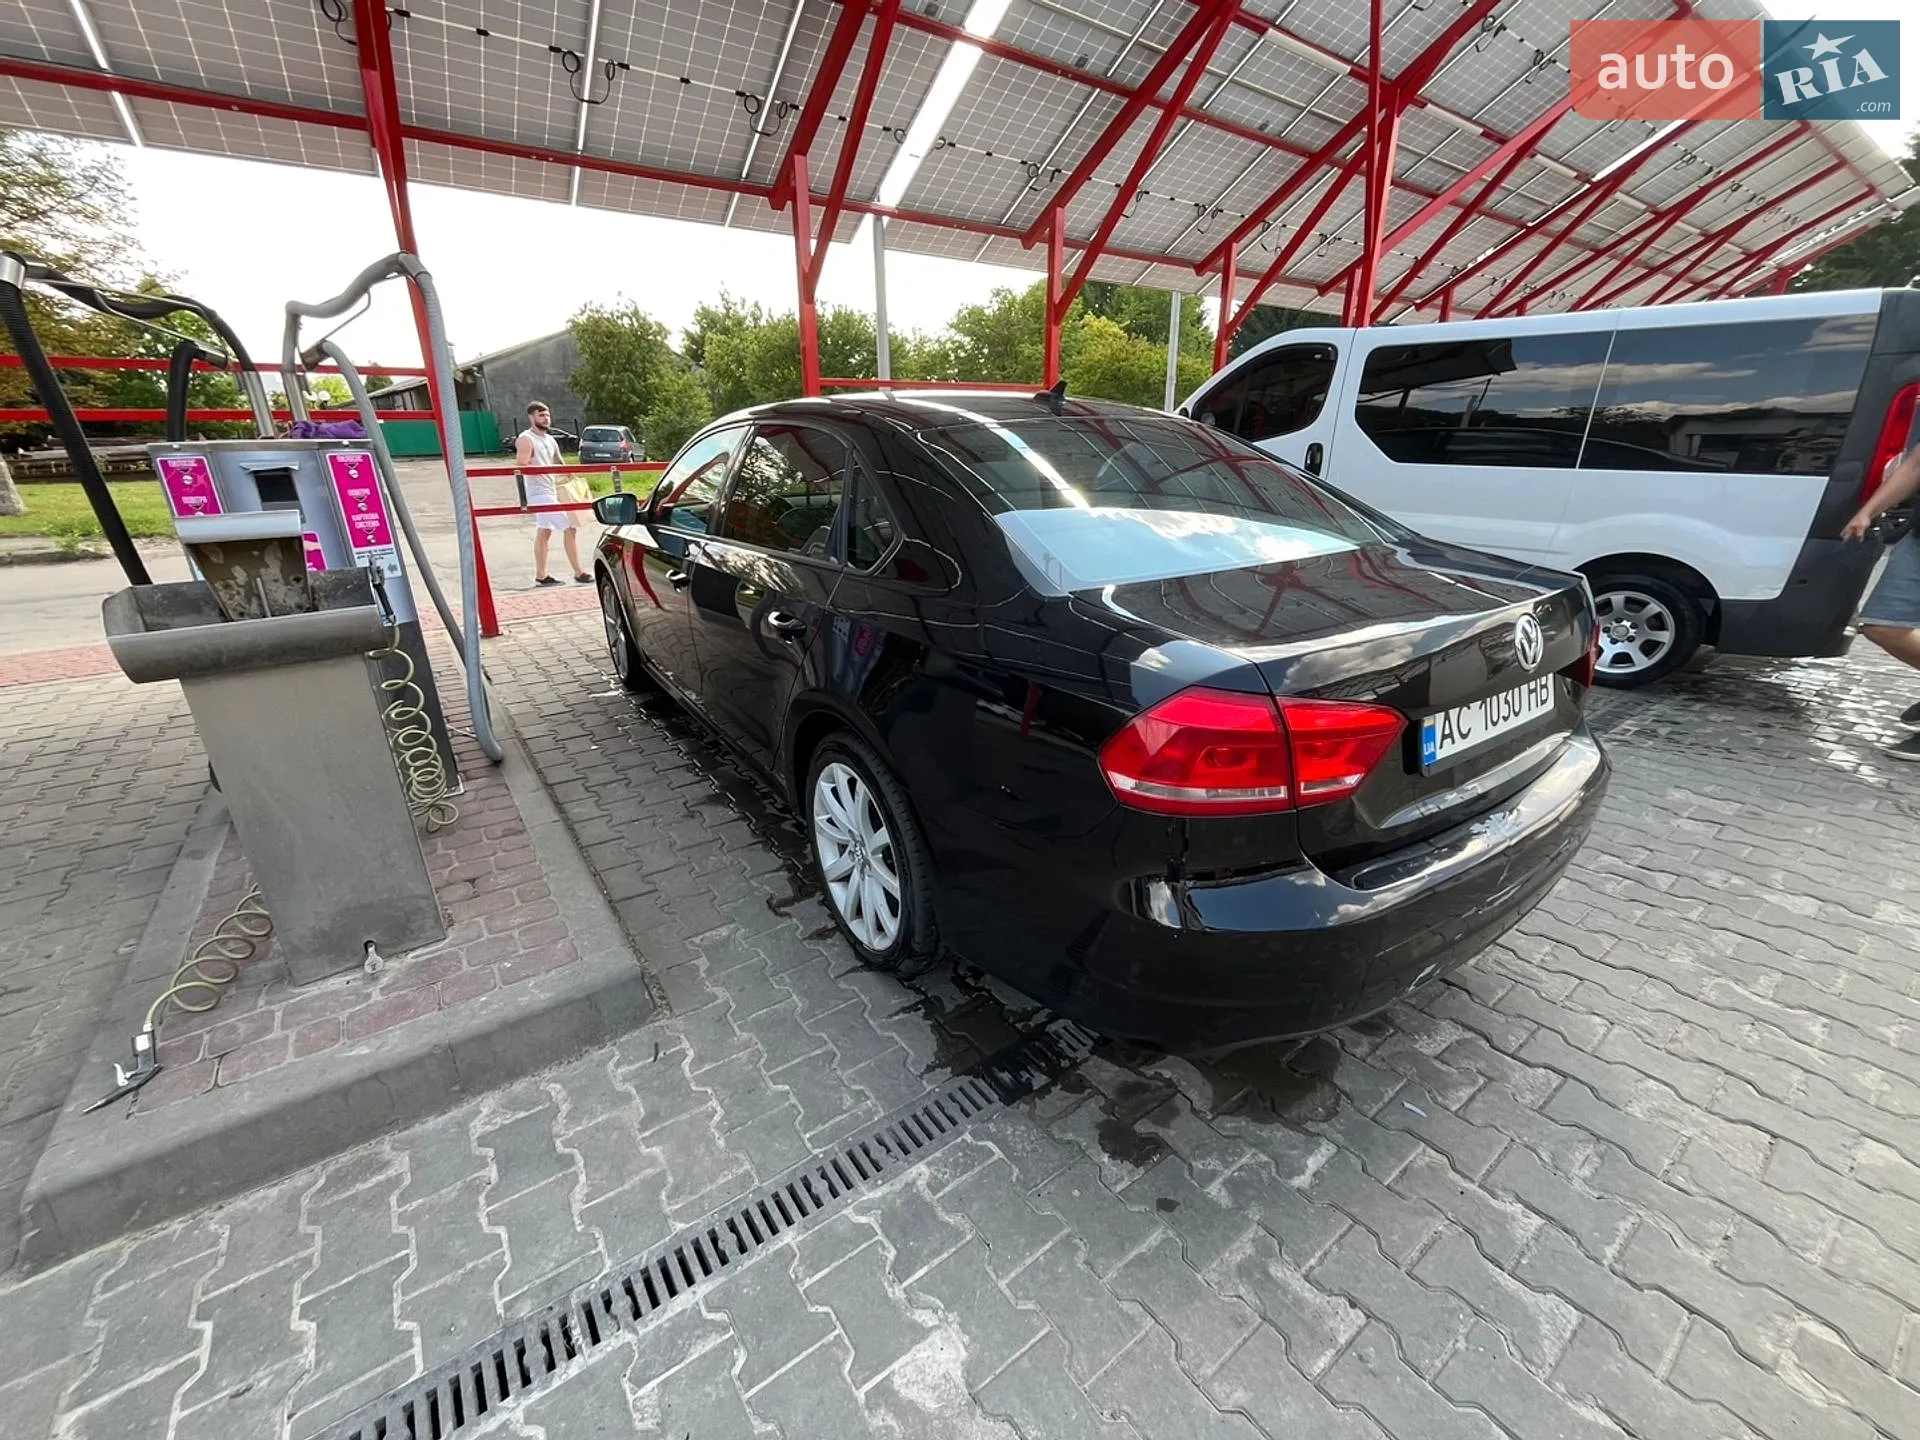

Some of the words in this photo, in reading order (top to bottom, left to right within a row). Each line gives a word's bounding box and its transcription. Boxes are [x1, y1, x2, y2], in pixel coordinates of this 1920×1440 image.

[1439, 704, 1471, 749] AC
[1478, 686, 1522, 731] 1030
[1528, 674, 1549, 711] HB
